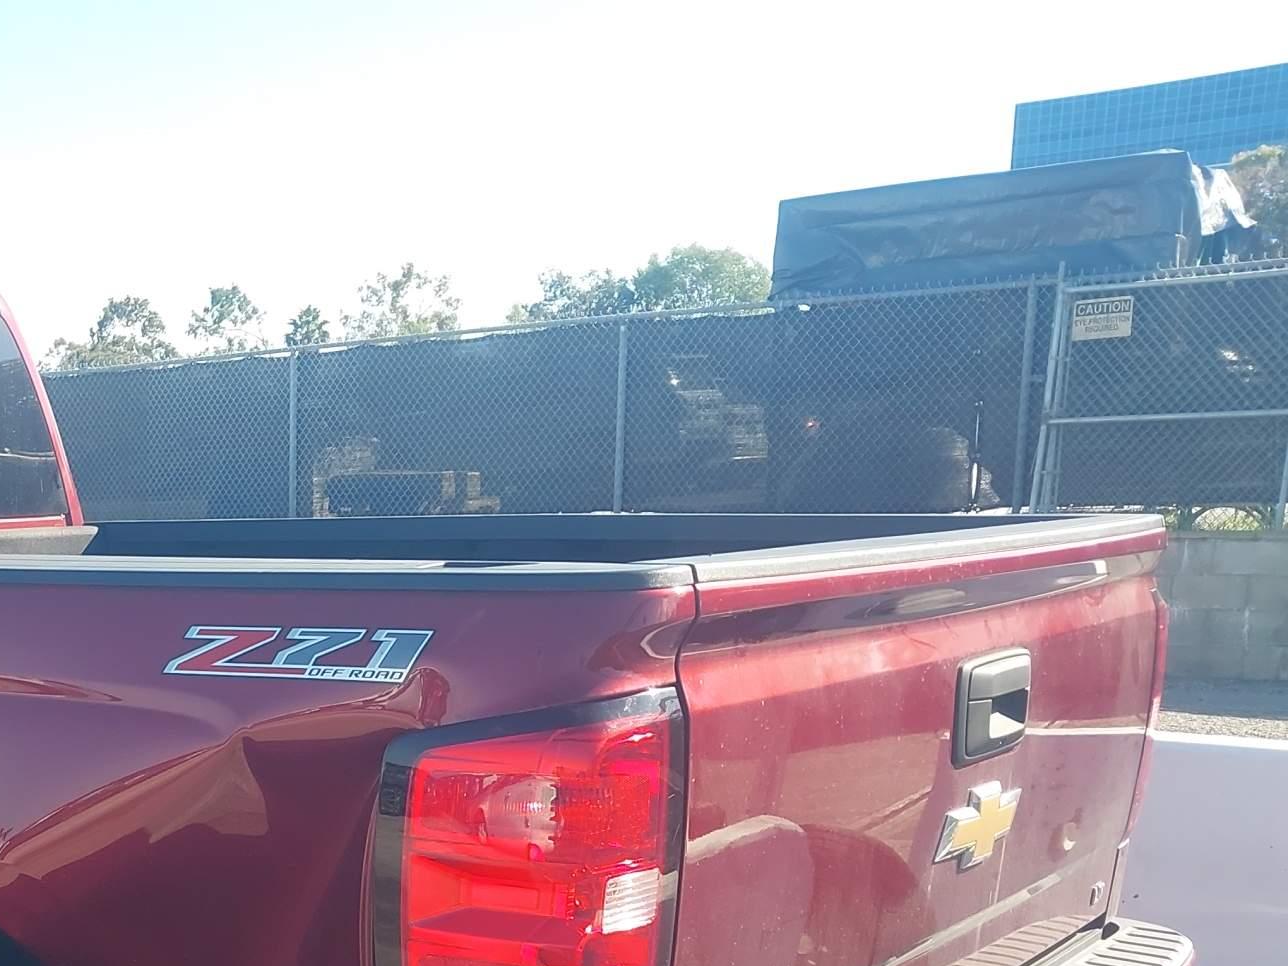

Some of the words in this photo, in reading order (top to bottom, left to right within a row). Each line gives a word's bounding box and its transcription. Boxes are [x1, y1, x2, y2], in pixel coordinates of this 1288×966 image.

[1077, 301, 1130, 315] CAUTION
[162, 625, 434, 682] Z71
[308, 667, 344, 677] OFF
[349, 669, 405, 680] ROAD
